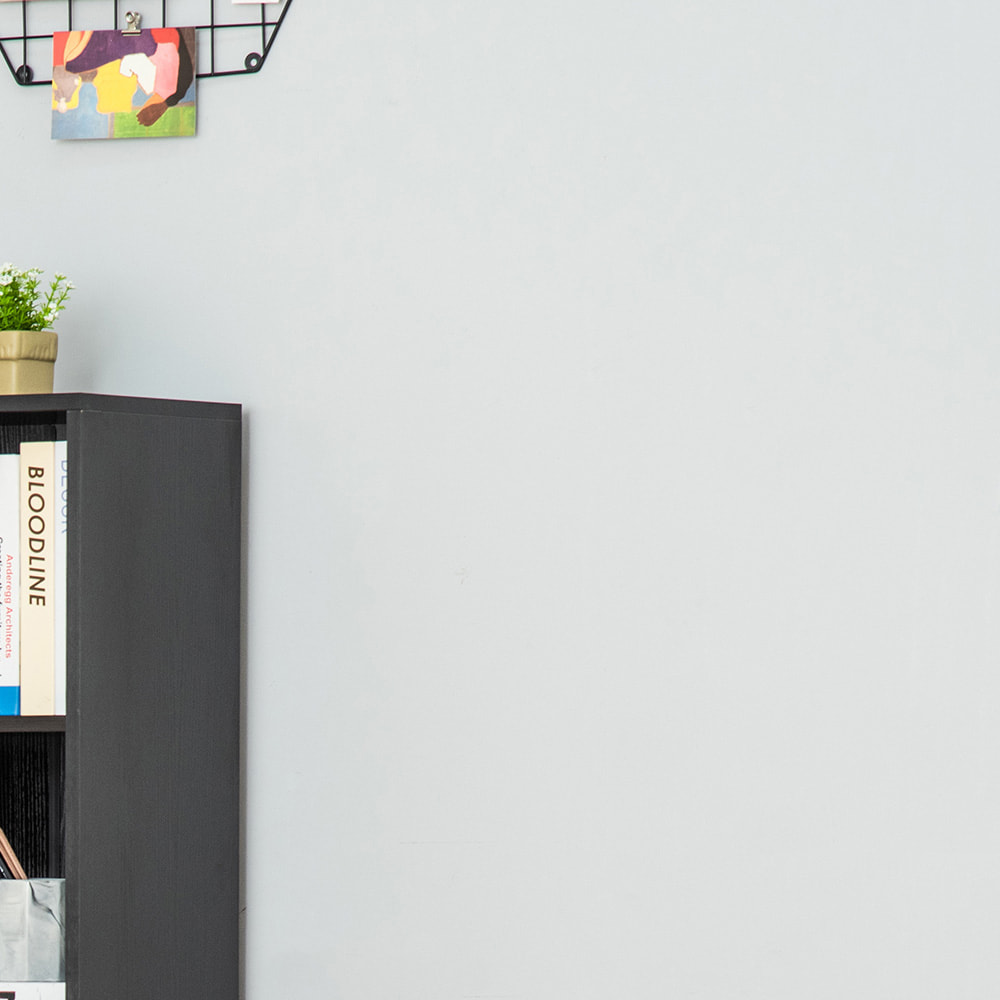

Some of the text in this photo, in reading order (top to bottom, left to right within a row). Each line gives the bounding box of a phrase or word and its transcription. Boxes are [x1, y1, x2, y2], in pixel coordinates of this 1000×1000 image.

[28, 466, 45, 606] BLOODLINE
[4, 554, 14, 659] Anderegg Architects
